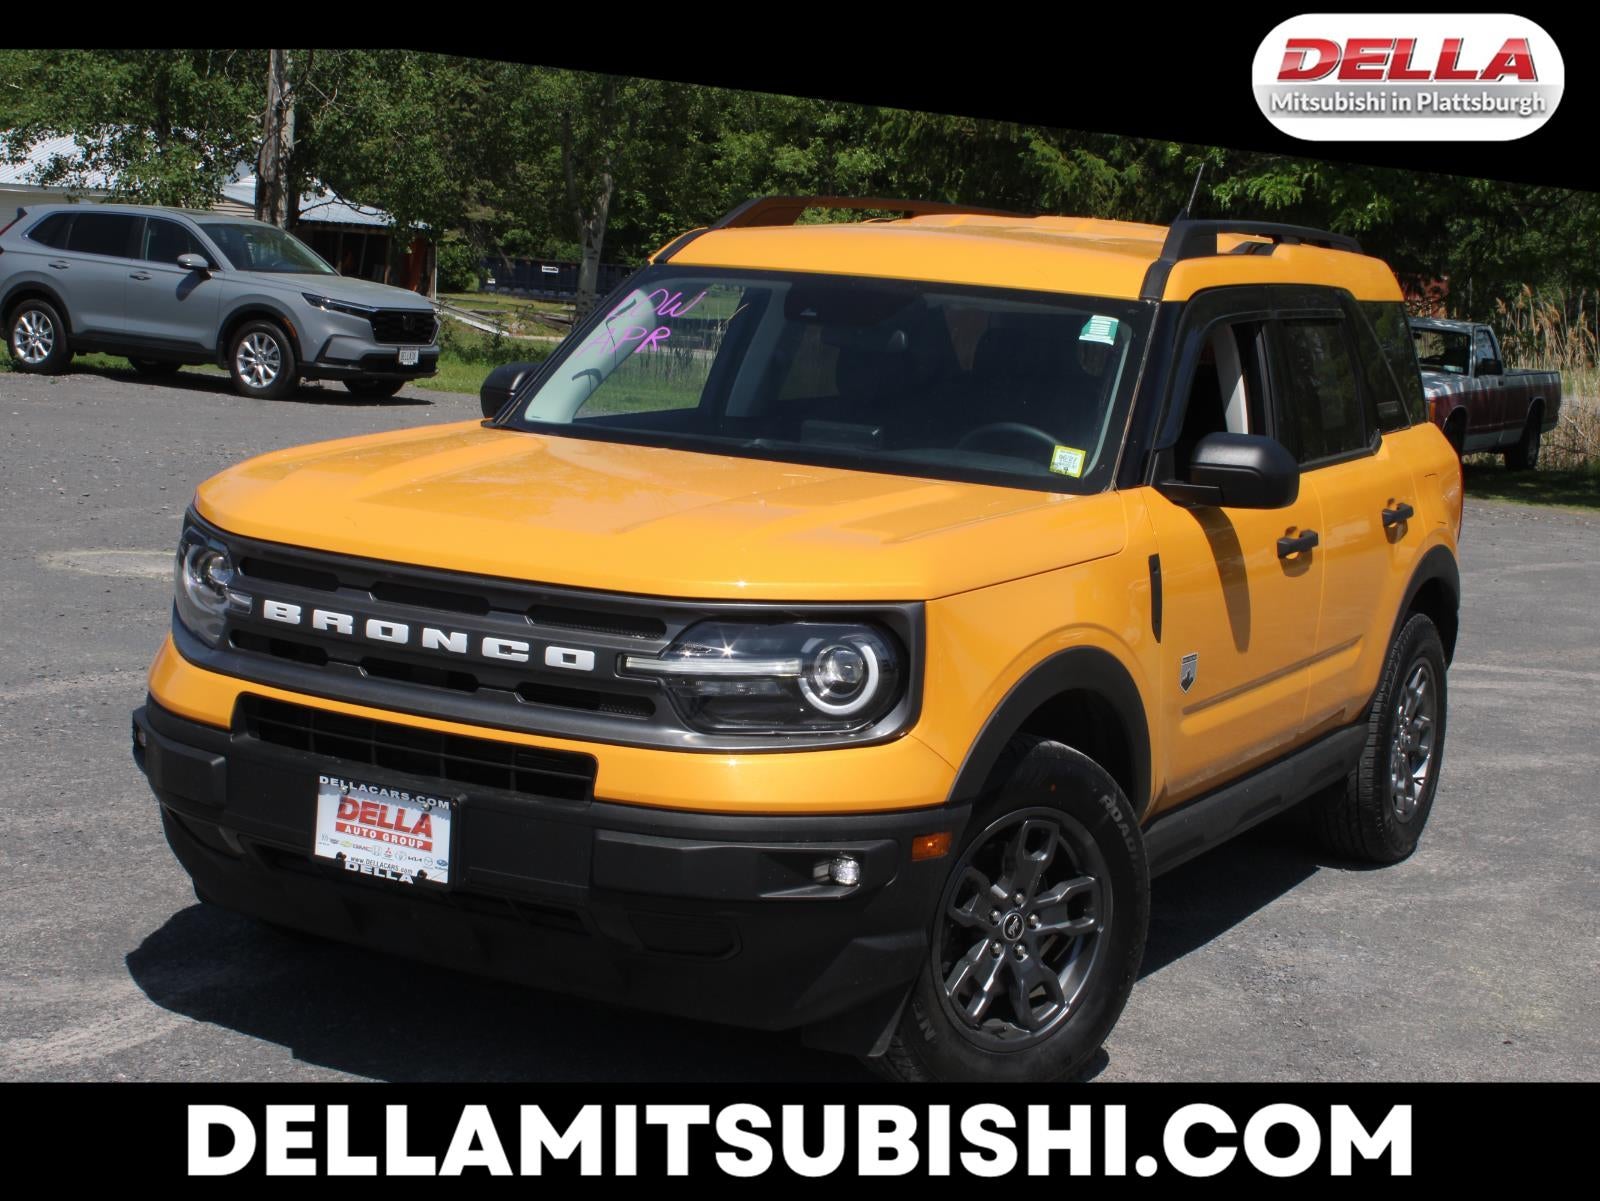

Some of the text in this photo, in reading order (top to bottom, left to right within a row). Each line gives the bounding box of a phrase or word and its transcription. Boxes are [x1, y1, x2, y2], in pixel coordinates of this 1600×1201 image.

[263, 599, 595, 672] BRONCO
[319, 775, 450, 810] DELLACARS.COM
[336, 796, 433, 839] DELLA
[344, 825, 424, 848] AUTO GROUP
[345, 860, 414, 885] DELLA
